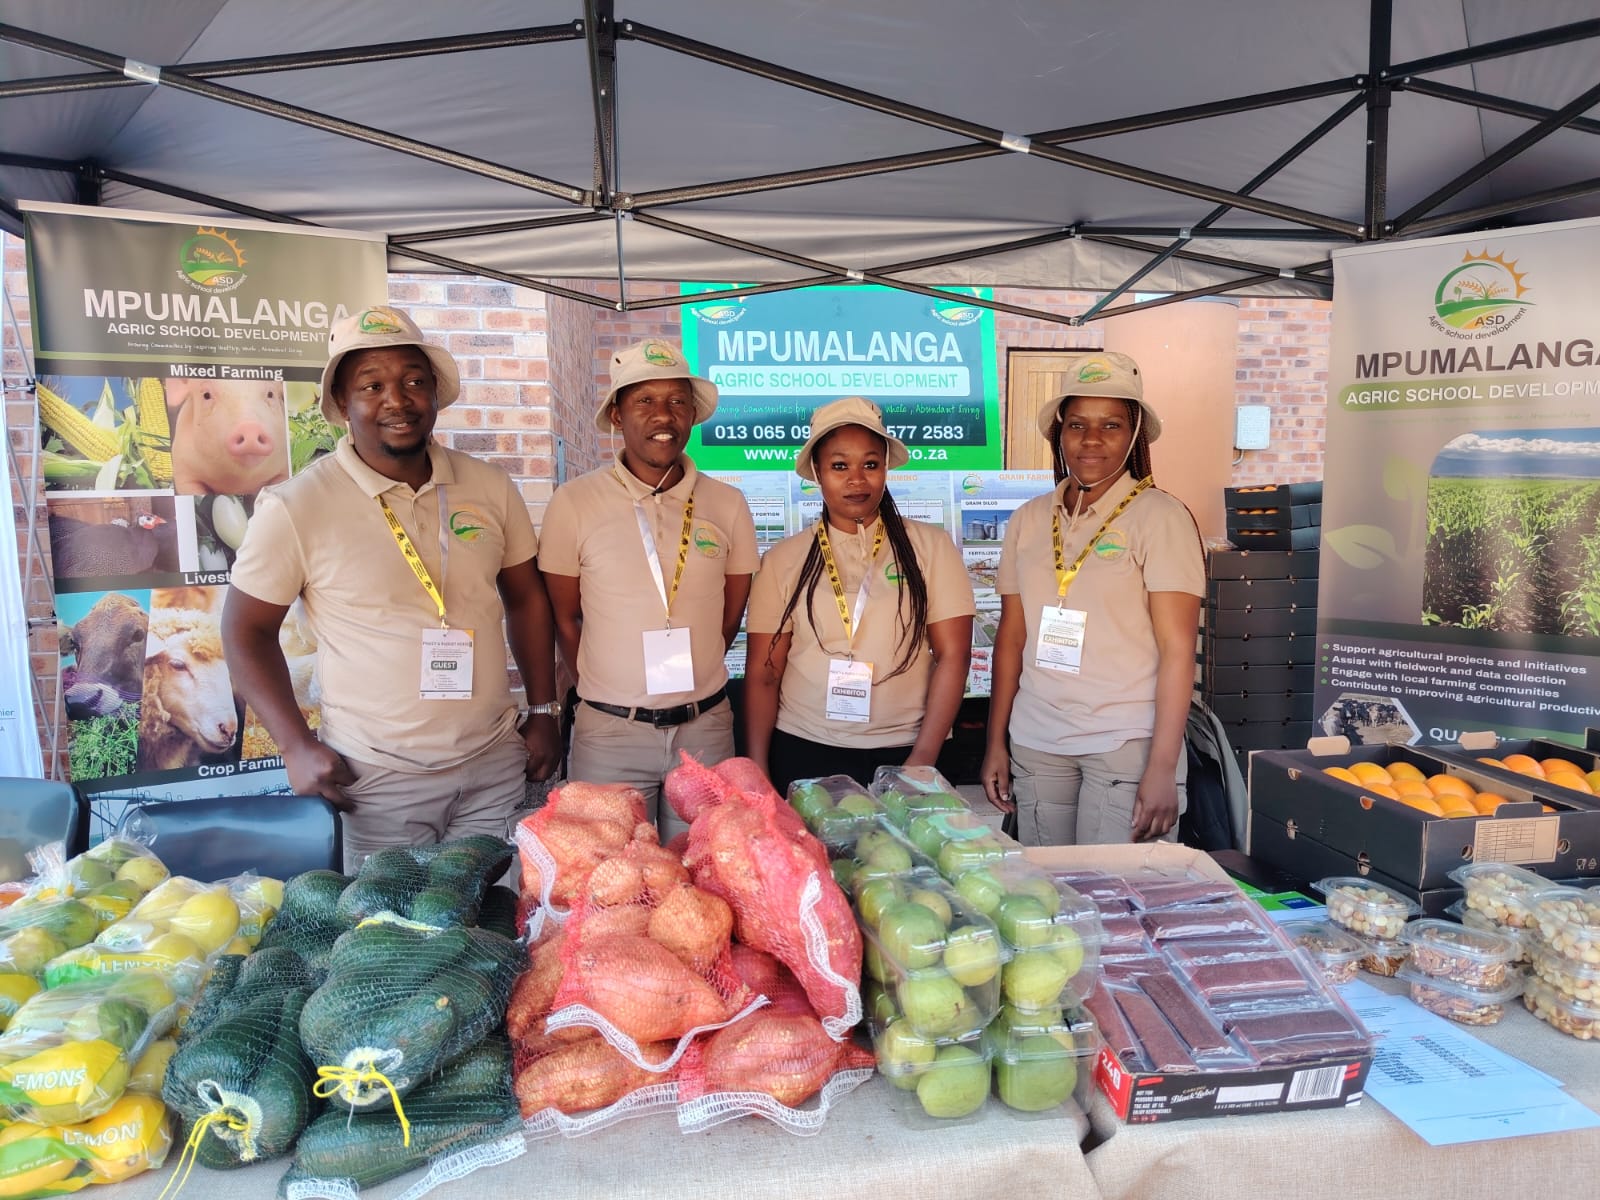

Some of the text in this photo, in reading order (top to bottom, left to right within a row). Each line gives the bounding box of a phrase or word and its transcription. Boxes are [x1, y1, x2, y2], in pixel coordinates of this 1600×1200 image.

[1428, 307, 1528, 340] Agric school development
[1474, 315, 1505, 327] ASD
[107, 322, 326, 343] AGRIC SCHOOL DEVELOPMENT
[718, 330, 963, 363] MPUMALANGA
[170, 364, 283, 381] Mixed Farming
[714, 371, 958, 389] AGRIC SCHOOL DEVELOPMENT
[1345, 380, 1600, 405] AGRIC SCHOOL DEVELOPM
[717, 405, 740, 419] owing
[715, 425, 811, 440] 013 065 09
[886, 425, 964, 440] 577 2583
[744, 448, 802, 461] www.a
[999, 473, 1024, 481] GRAIN
[185, 571, 232, 585] Livest
[1332, 643, 1587, 675] Support agricultural projects and initiatives
[1332, 655, 1567, 686] Assist with fieldwork and data collection
[1331, 667, 1560, 698] Engage with local farming communities
[833, 688, 866, 697] EXHIBITOR
[1331, 678, 1600, 716] Contribute to improving agricultural productiv
[198, 754, 286, 778] Crop Farmi
[1170, 1087, 1217, 1104] Black Label
